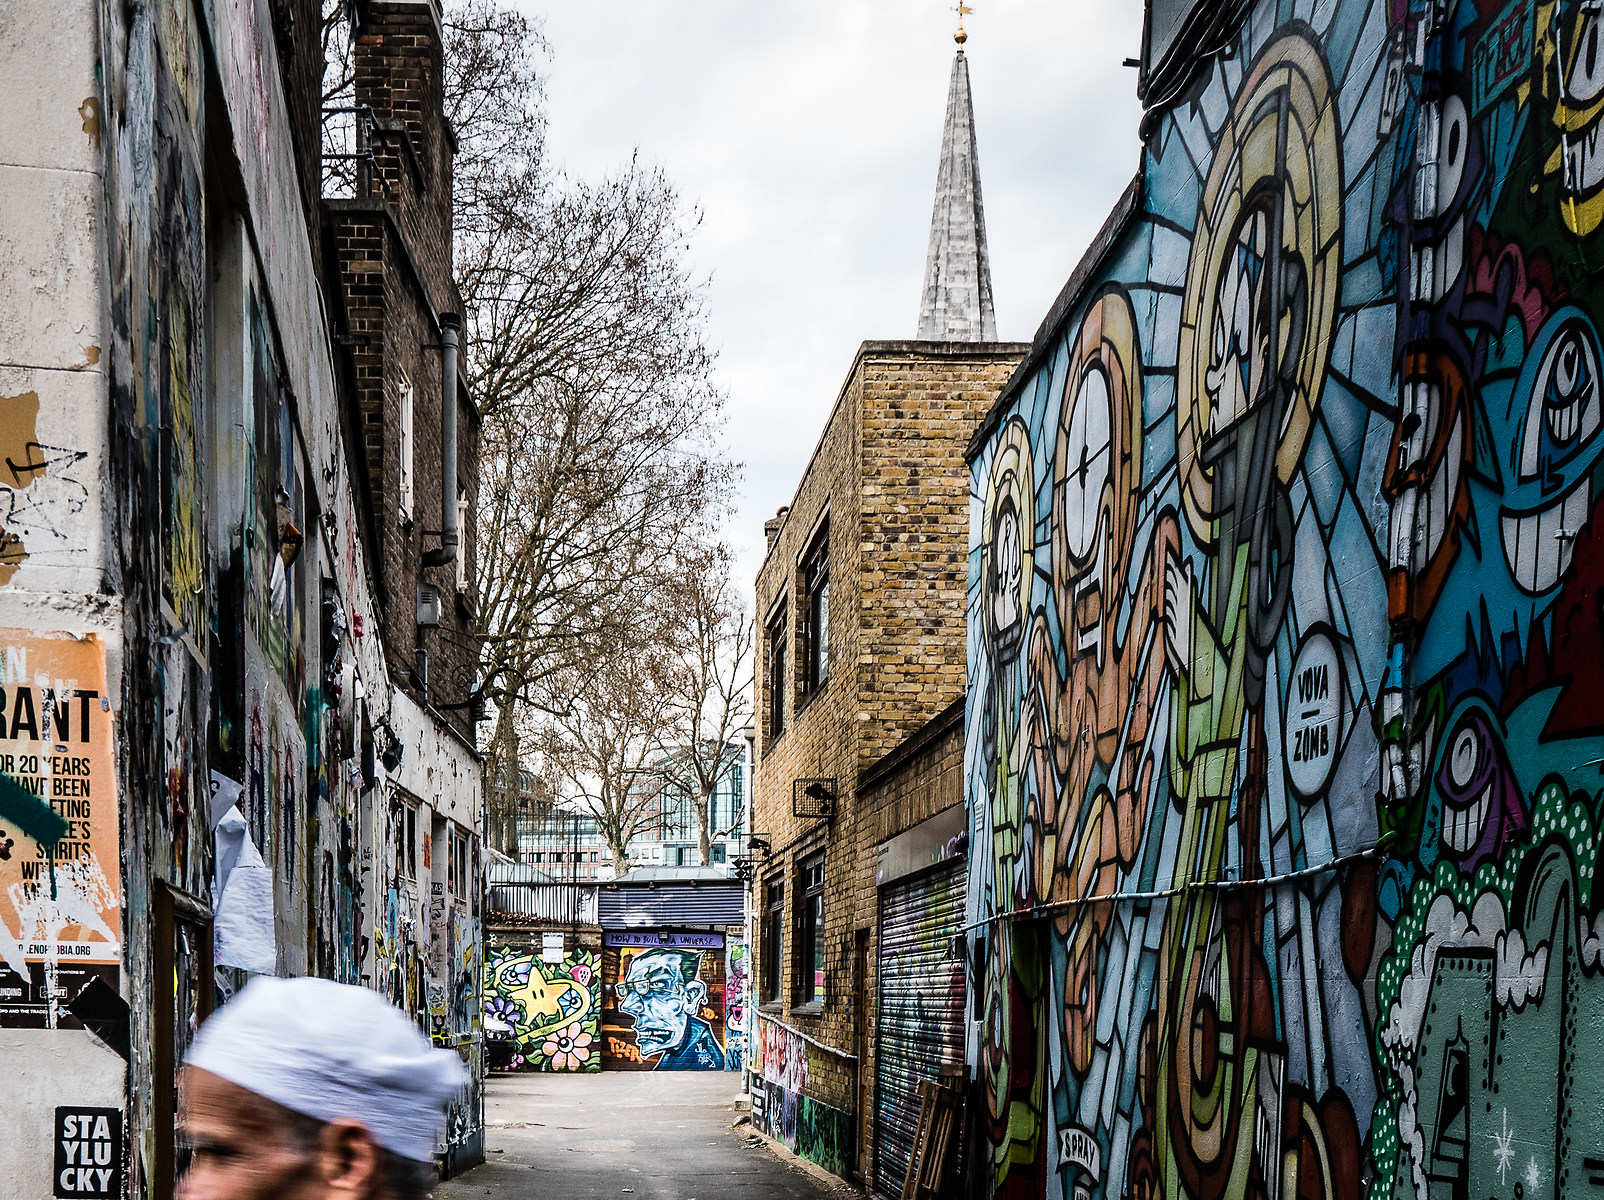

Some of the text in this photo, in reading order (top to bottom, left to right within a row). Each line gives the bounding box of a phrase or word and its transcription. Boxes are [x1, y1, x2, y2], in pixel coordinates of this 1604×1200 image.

[1298, 664, 1329, 703] VOVA
[1293, 724, 1329, 762] ZOMB
[19, 755, 38, 773] 20
[53, 777, 90, 797] BEEN
[36, 841, 90, 861] SIRITS
[610, 934, 630, 944] HOW
[672, 936, 677, 944] A
[680, 936, 714, 946] UNIVERSE
[63, 1114, 111, 1140] STA
[61, 1140, 112, 1166] YLU
[1065, 1131, 1095, 1168] SPRAY
[60, 1167, 114, 1193] CKY
